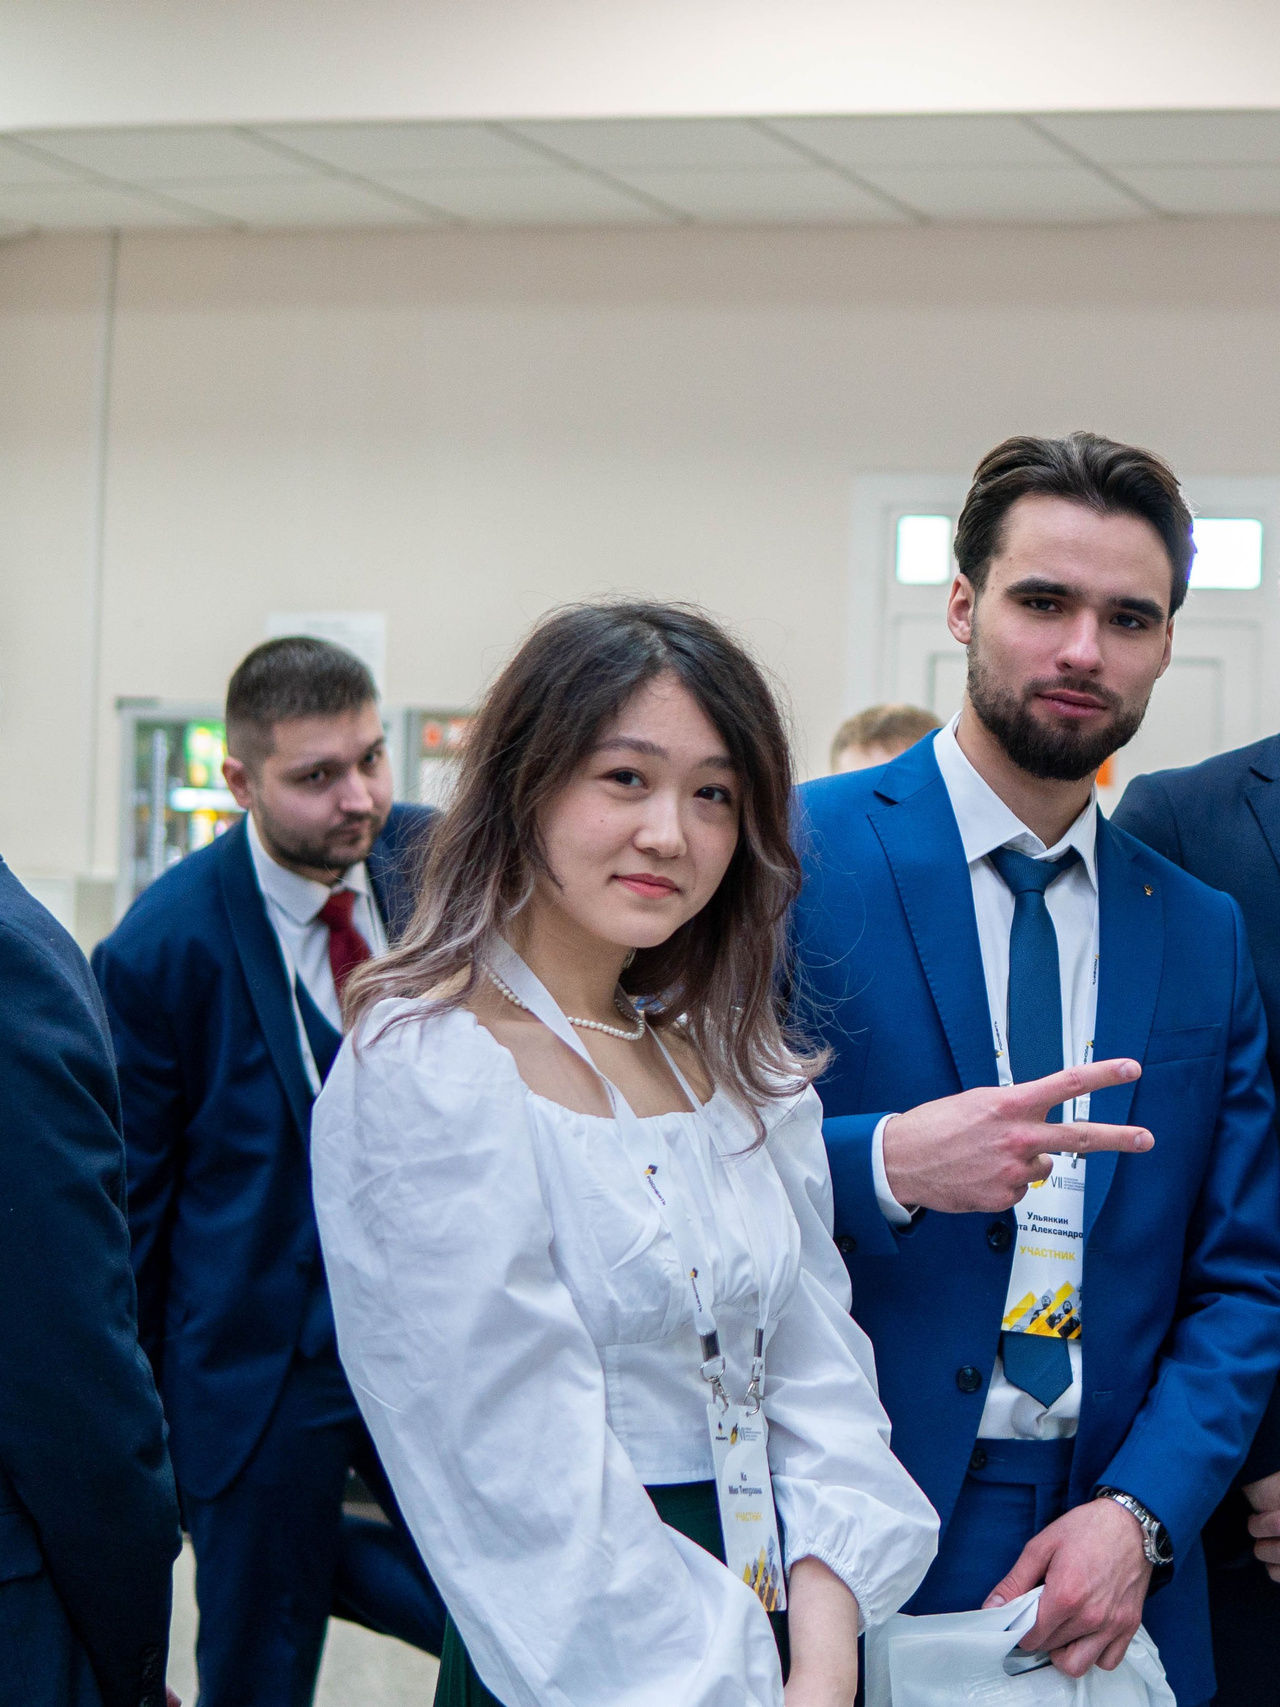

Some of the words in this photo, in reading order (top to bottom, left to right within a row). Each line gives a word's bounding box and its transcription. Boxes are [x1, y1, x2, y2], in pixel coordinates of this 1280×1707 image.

[1050, 1175, 1063, 1189] VII
[1026, 1211, 1069, 1225] Ульянкин
[1019, 1245, 1076, 1262] УЧАСТНИК
